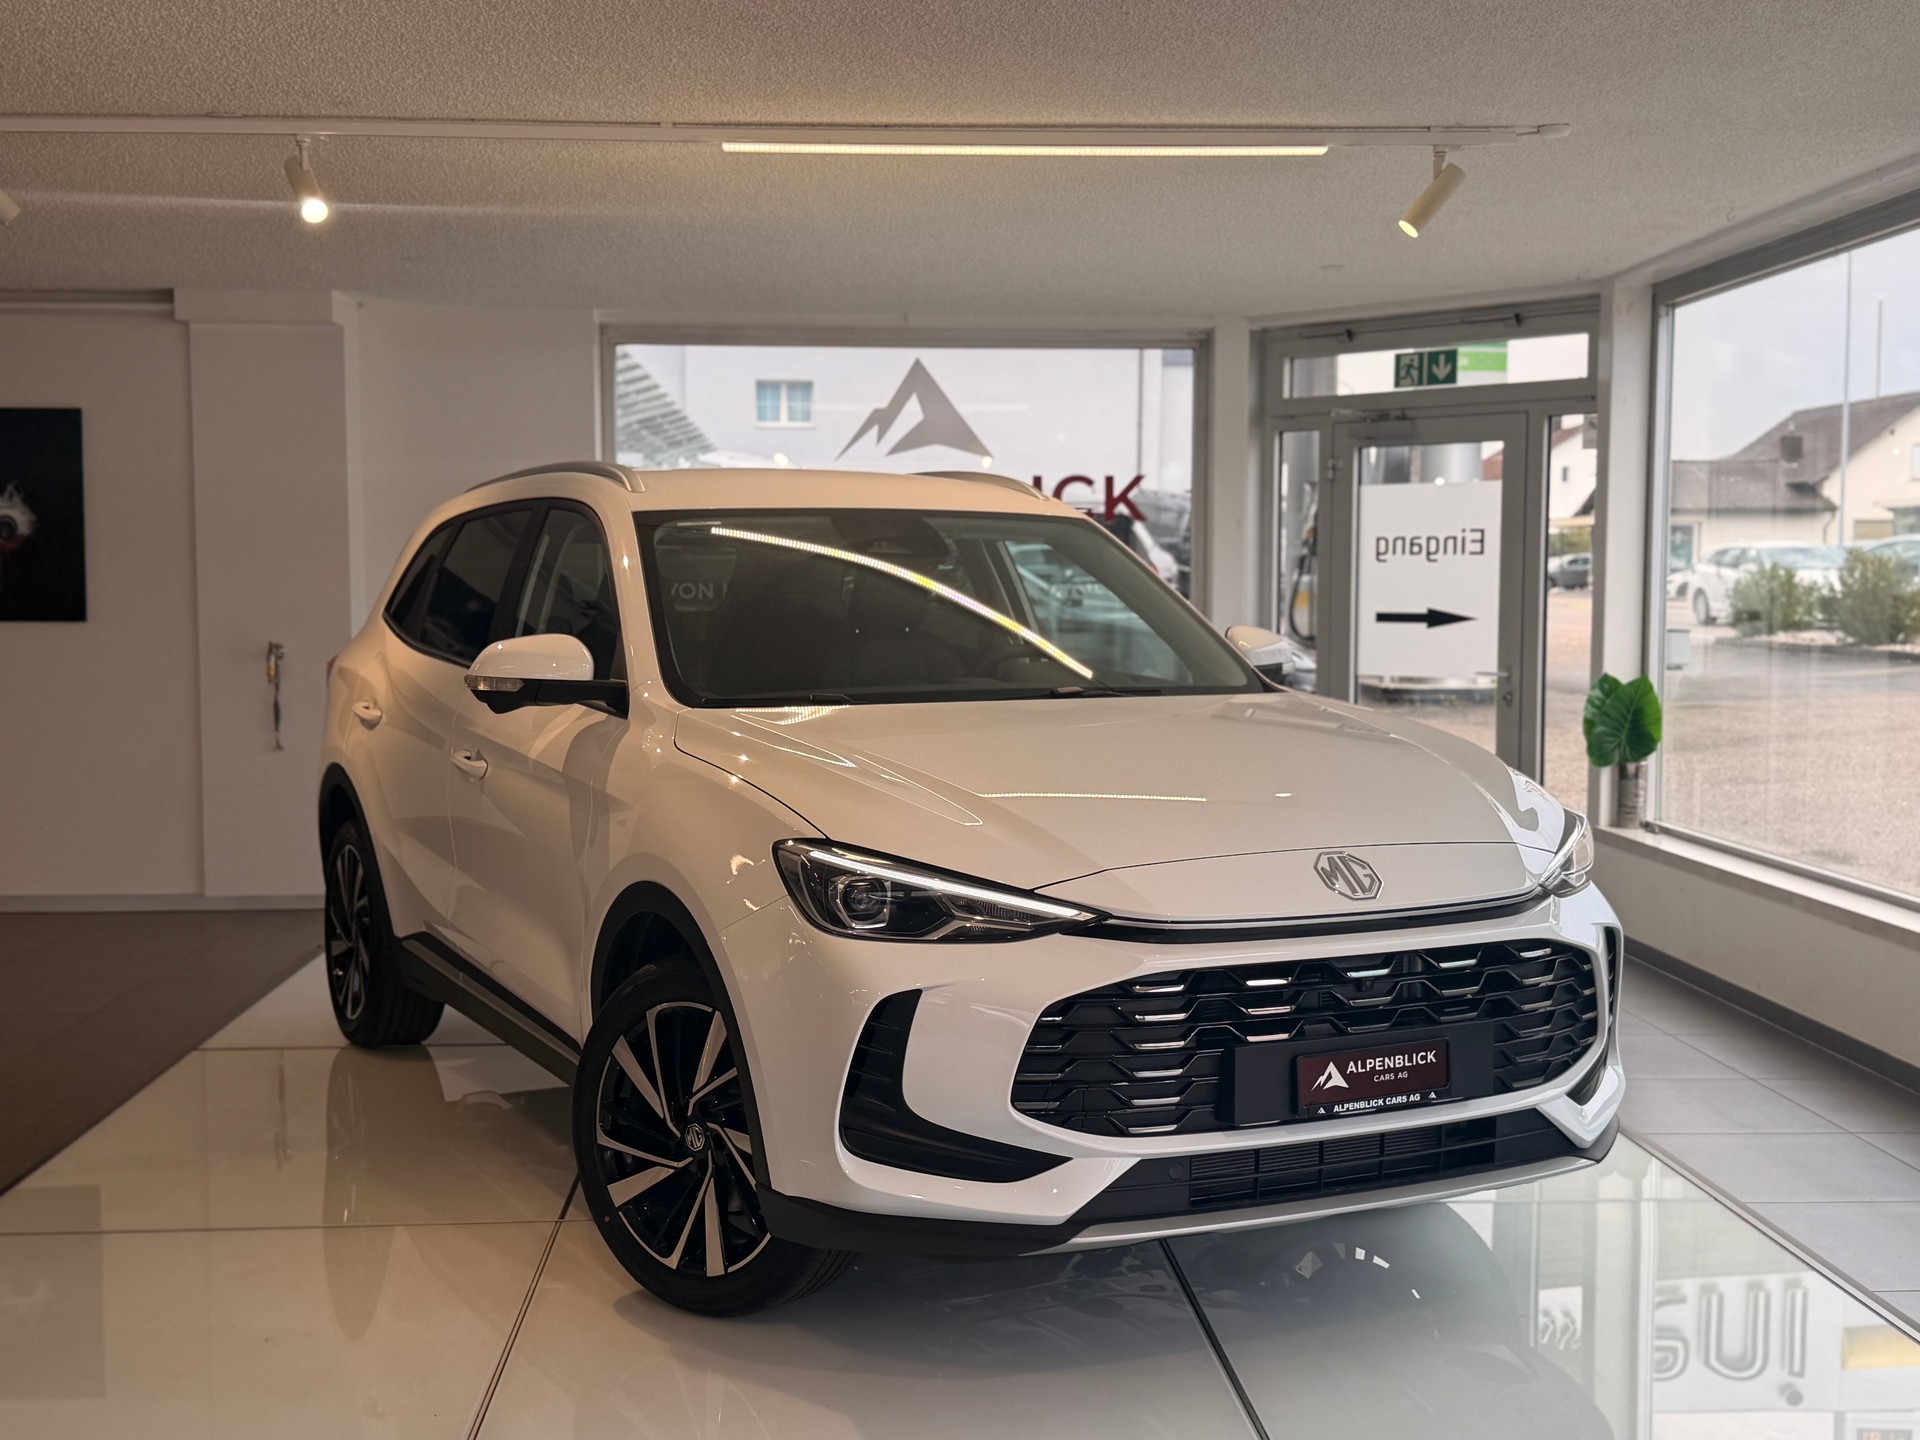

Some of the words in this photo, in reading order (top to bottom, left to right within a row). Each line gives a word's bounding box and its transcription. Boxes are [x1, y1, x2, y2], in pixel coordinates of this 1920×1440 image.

[1320, 855, 1378, 896] MG
[1347, 1051, 1436, 1074] ALPENBLICK
[1373, 1074, 1395, 1082] CARS
[1397, 1070, 1408, 1079] AG
[1333, 1099, 1384, 1112] ALPENBLICK
[1385, 1095, 1407, 1106] CARS
[1409, 1093, 1421, 1101] AG
[687, 1126, 703, 1148] MG
